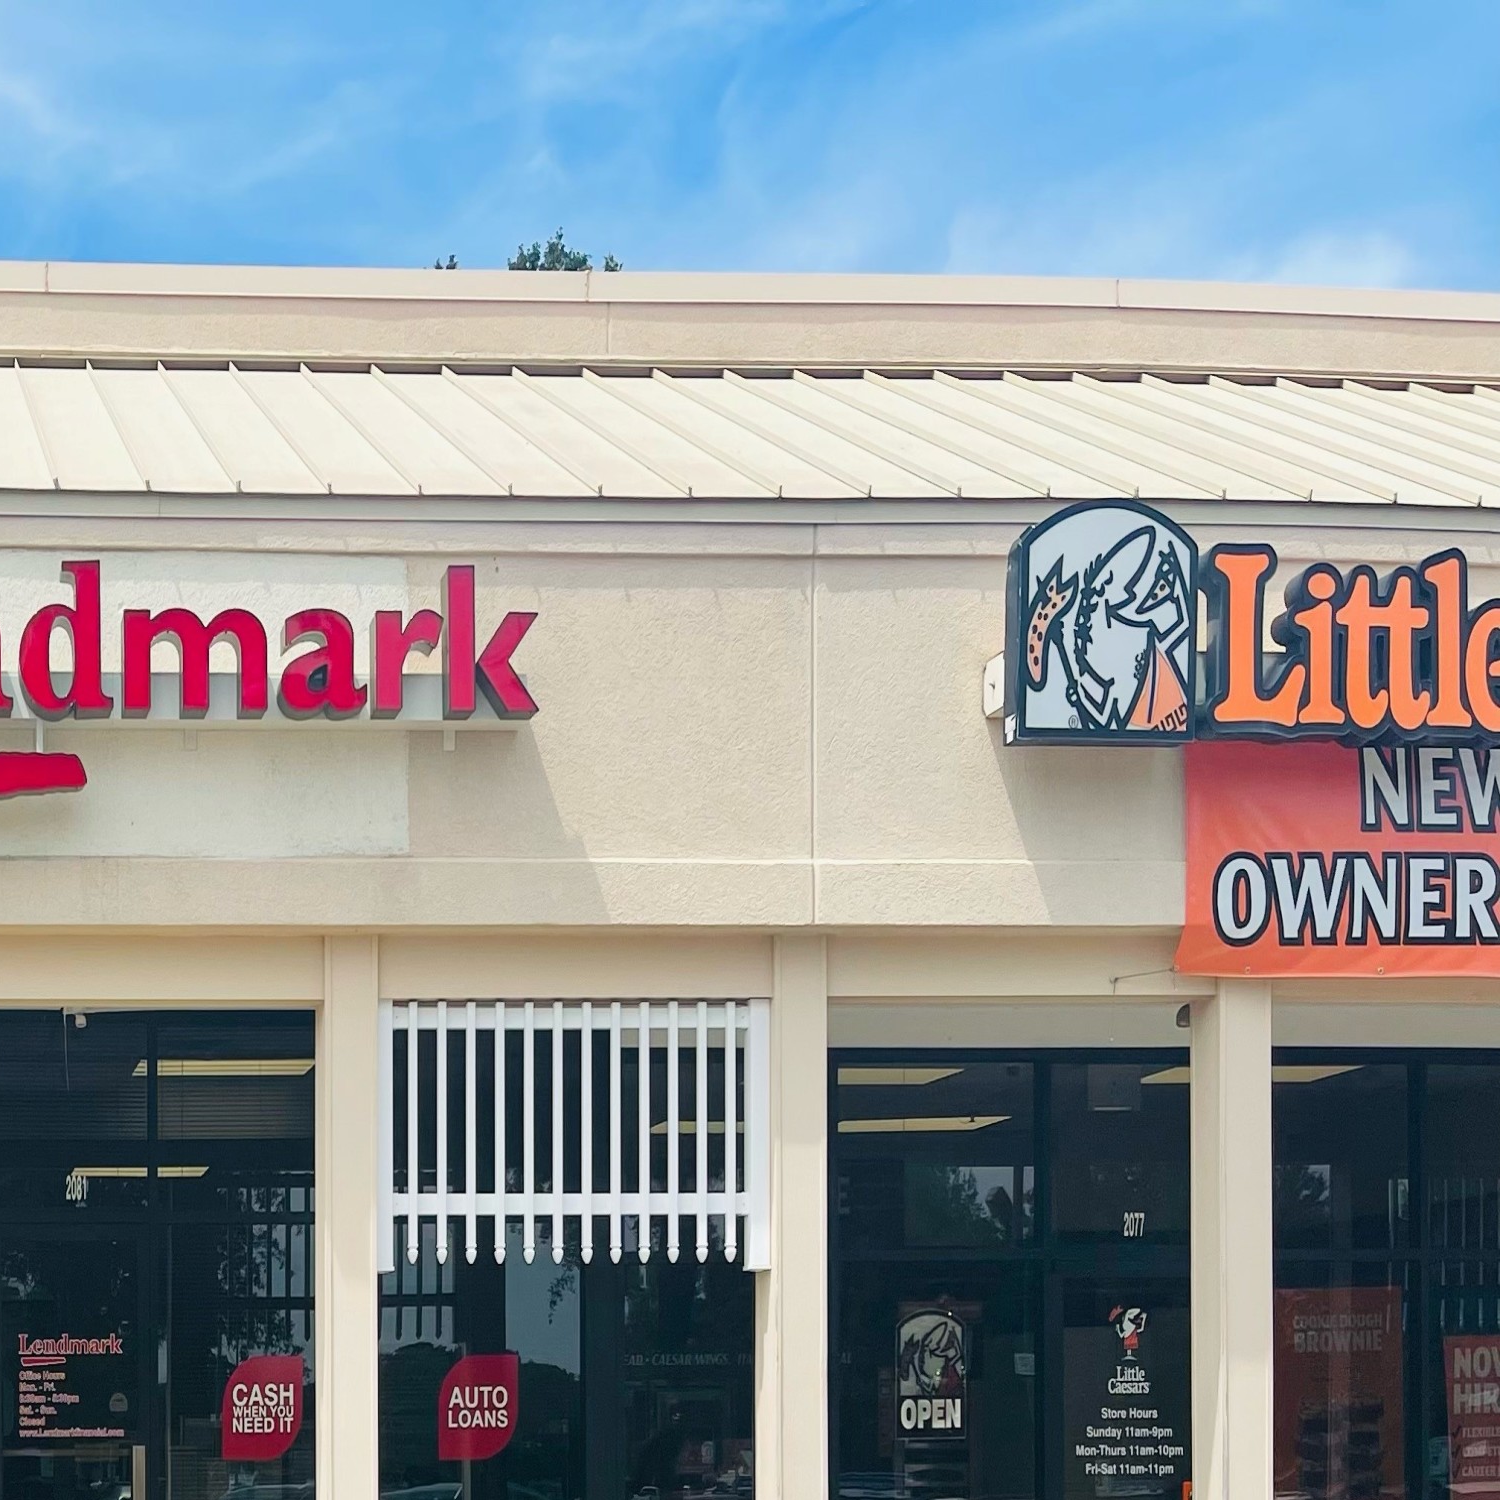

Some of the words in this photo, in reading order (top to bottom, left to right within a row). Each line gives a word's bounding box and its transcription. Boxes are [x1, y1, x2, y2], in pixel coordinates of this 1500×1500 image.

[65, 1174, 87, 1201] 2081
[1123, 1211, 1145, 1237] 2077
[18, 1332, 123, 1355] Lendmark
[1293, 1330, 1382, 1353] BROWNIE
[1116, 1366, 1146, 1382] Little
[232, 1383, 294, 1406] CASH
[1107, 1378, 1151, 1394] Caesars
[448, 1386, 508, 1409] AUTO
[233, 1406, 267, 1418] WHEN
[270, 1405, 294, 1418] YOU
[448, 1410, 509, 1429] LOANS
[900, 1398, 962, 1430] OPEN
[1101, 1407, 1127, 1419] Store
[1129, 1407, 1158, 1419] Hours
[232, 1417, 275, 1433] NEED
[279, 1417, 294, 1433] IT
[1086, 1426, 1122, 1440] Sunday
[1125, 1426, 1173, 1440] 11am-9pm
[1075, 1444, 1127, 1456] Mon-Thurs
[1129, 1444, 1184, 1458] 11am-10pm
[1085, 1463, 1117, 1475] Fri-Sat
[1119, 1463, 1174, 1477] 11am-11pm
